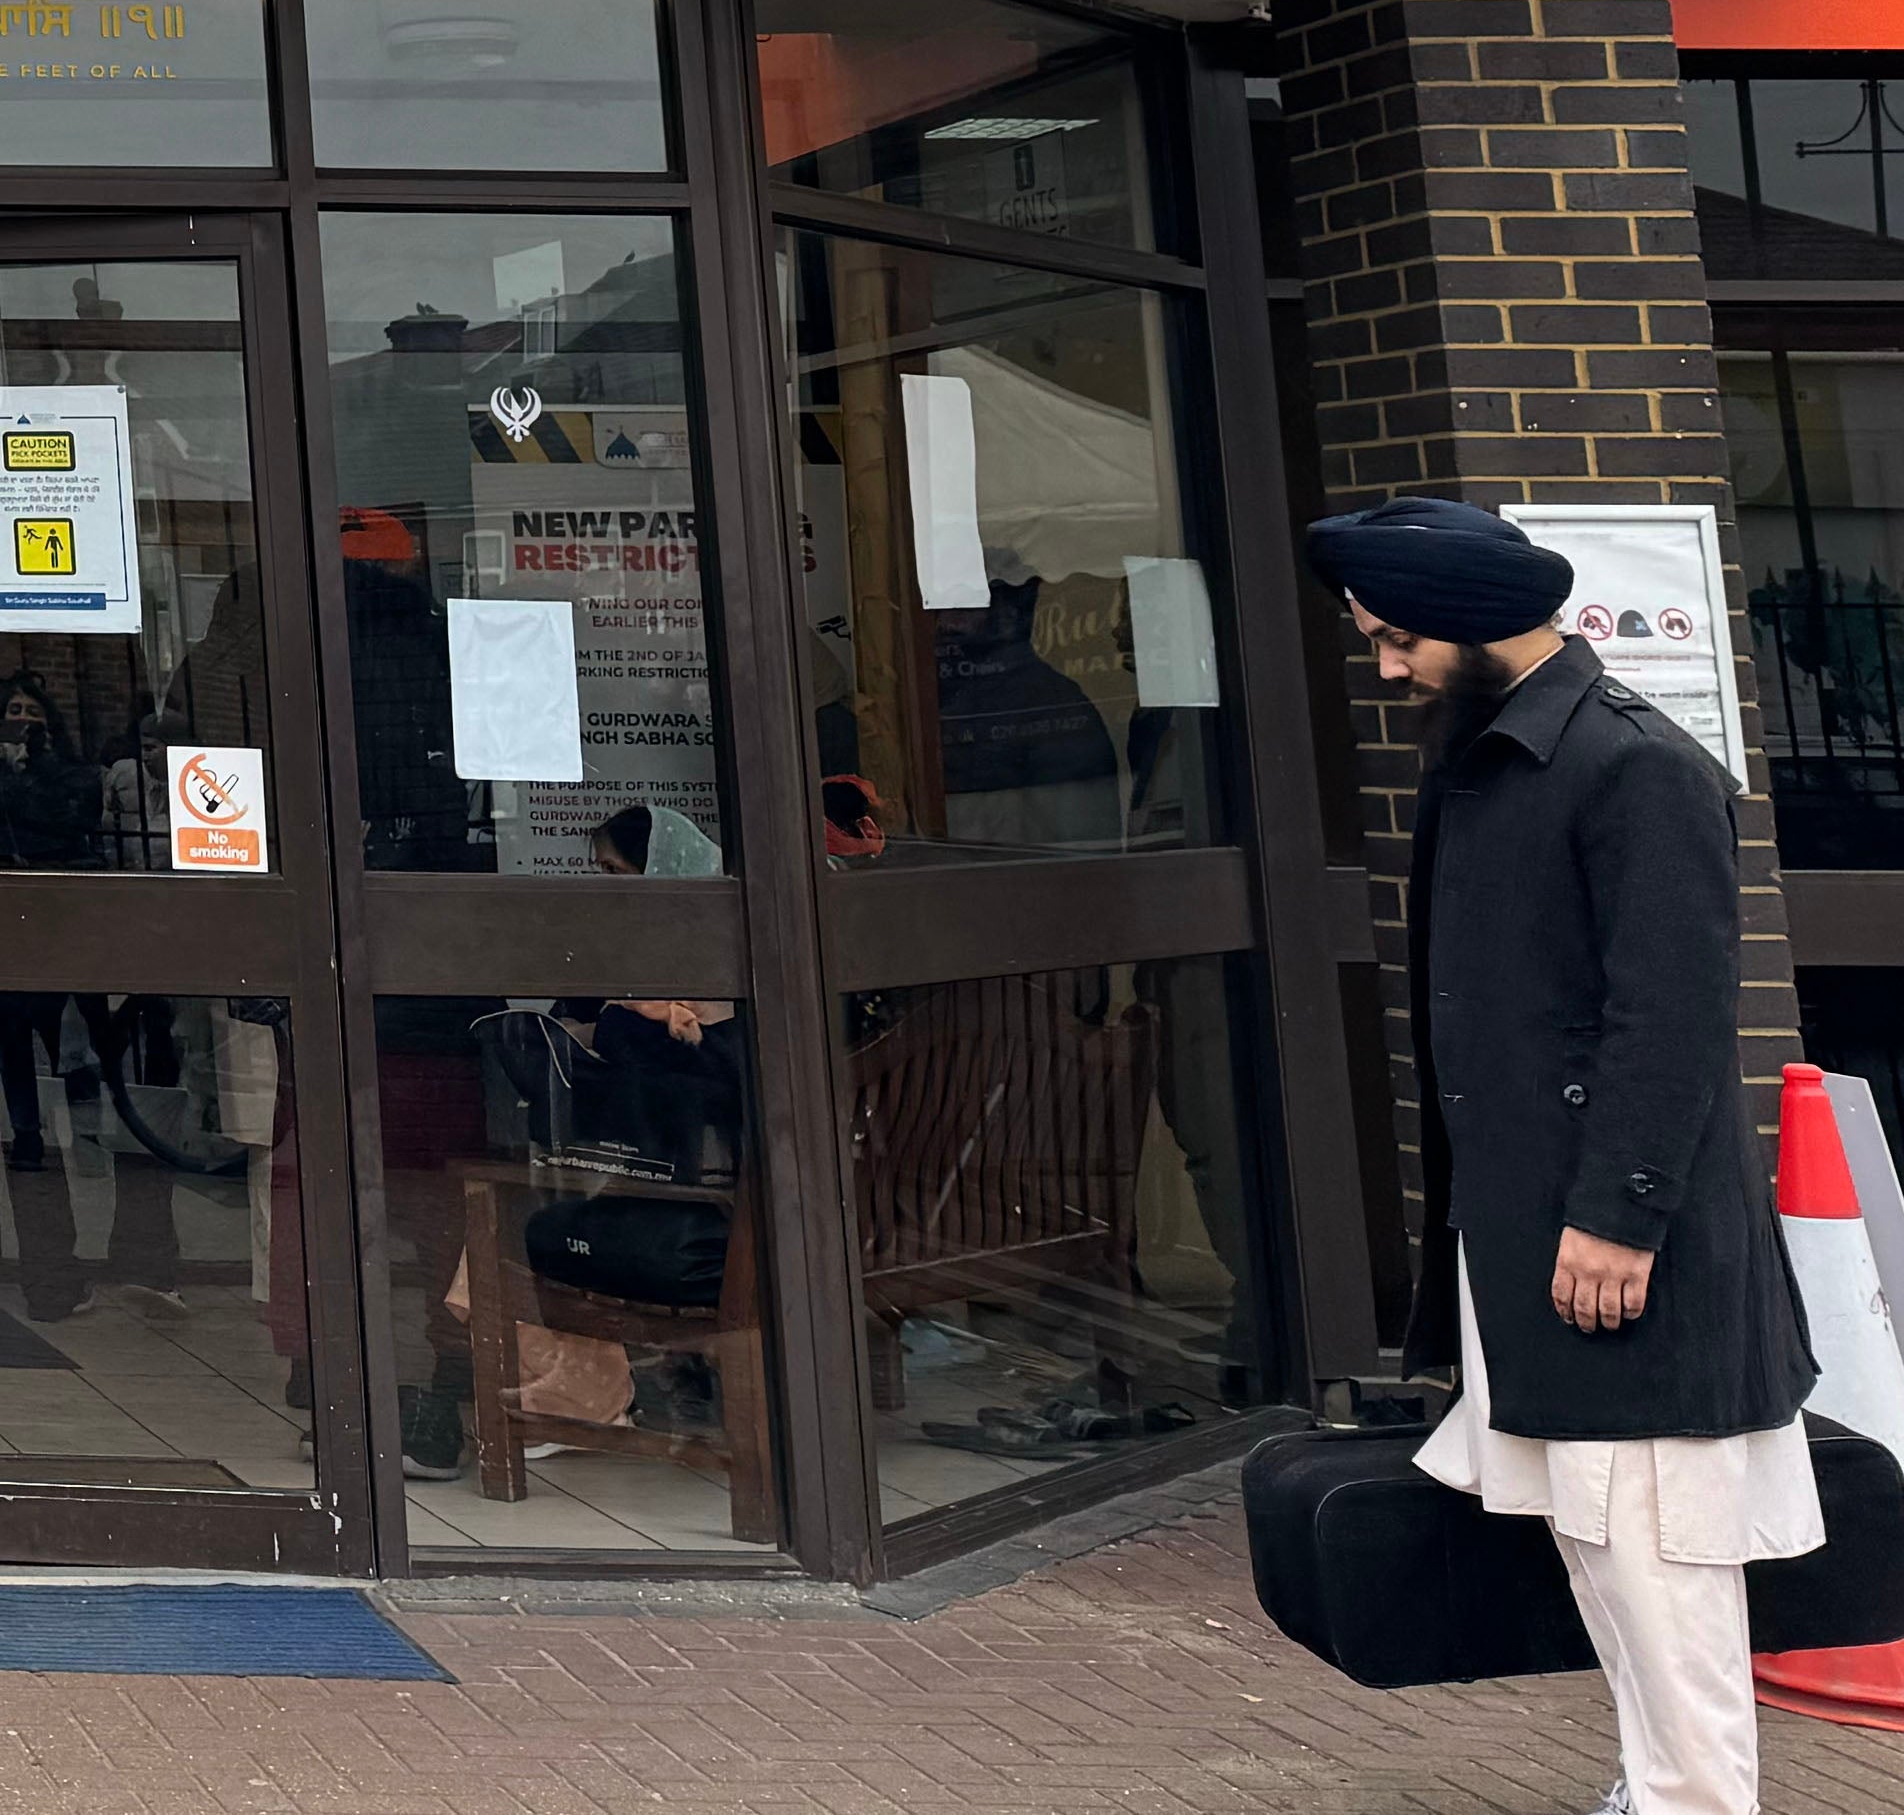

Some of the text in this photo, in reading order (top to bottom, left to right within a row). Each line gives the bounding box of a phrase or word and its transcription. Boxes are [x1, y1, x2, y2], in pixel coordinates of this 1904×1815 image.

[19, 62, 78, 78] FEET
[90, 62, 122, 78] OF
[132, 62, 178, 78] ALL
[999, 187, 1059, 228] GENTS
[10, 438, 66, 449] CAUTION
[512, 511, 612, 538] NEW
[586, 712, 700, 728] GURDWARA
[623, 731, 690, 746] SABHA
[208, 831, 229, 845] No
[189, 845, 249, 863] smoking
